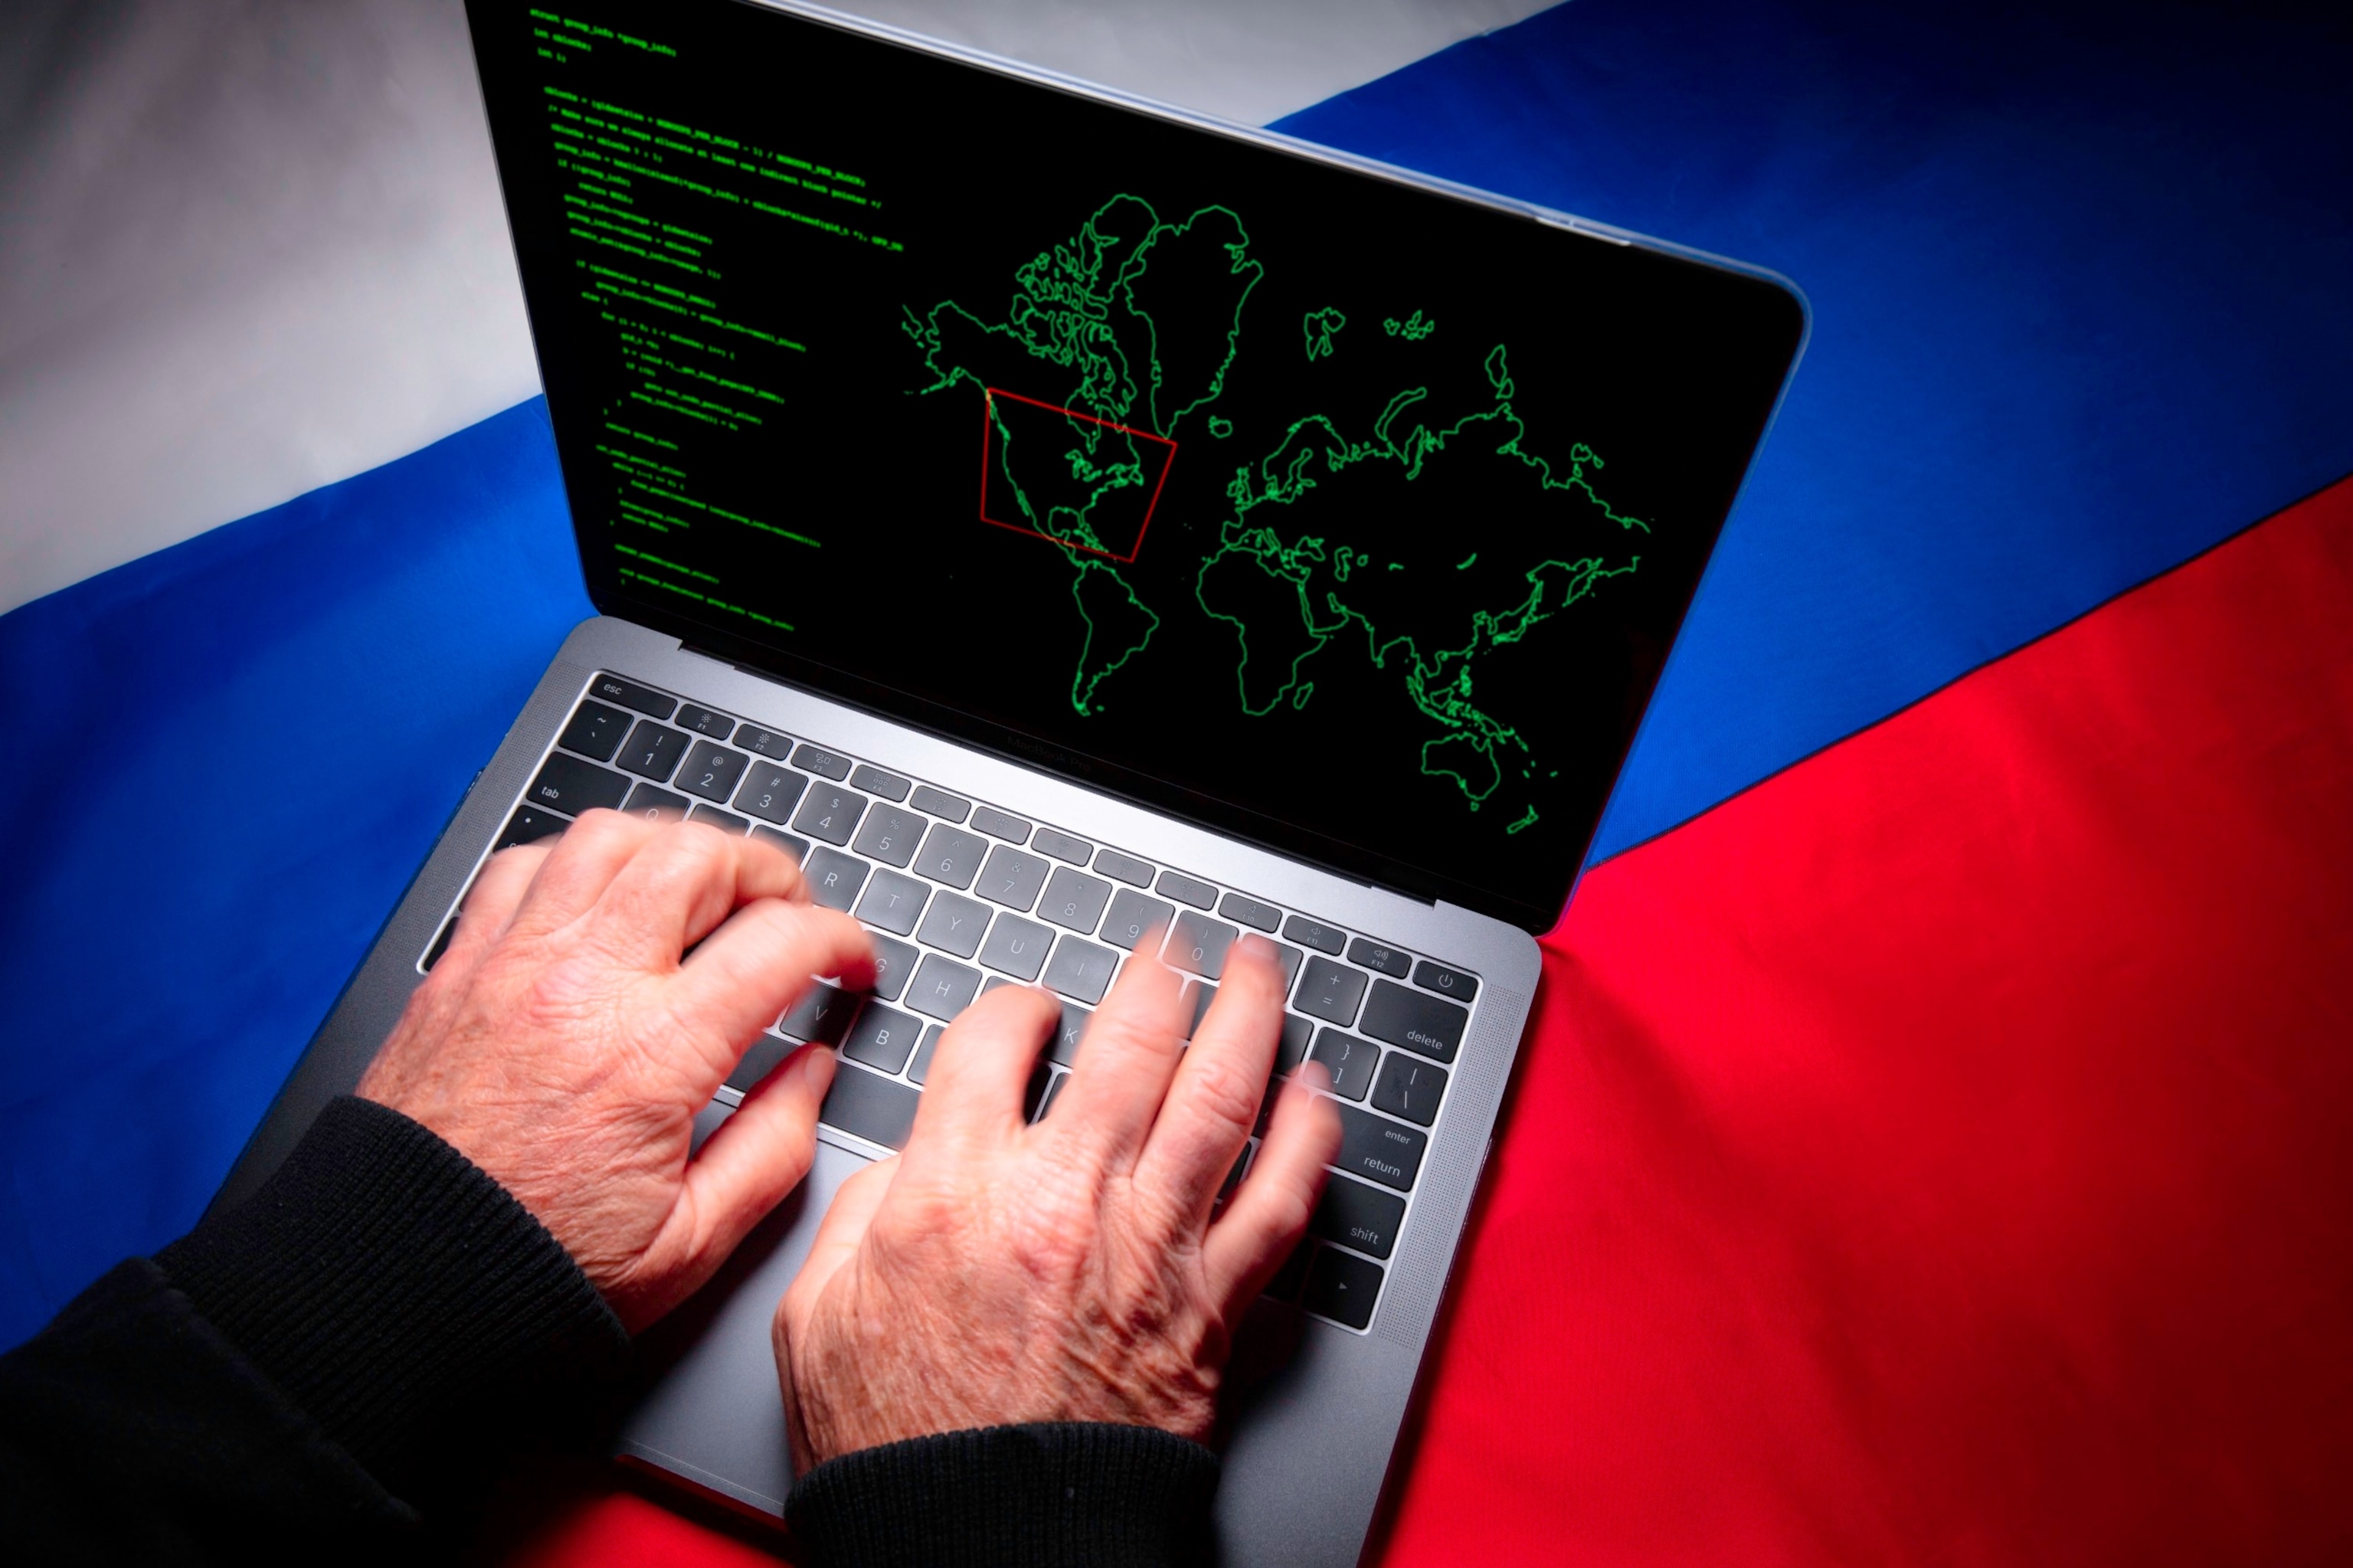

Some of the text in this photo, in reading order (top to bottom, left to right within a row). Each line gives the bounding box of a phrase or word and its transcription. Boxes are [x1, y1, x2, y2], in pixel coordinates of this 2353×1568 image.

[604, 683, 622, 695] esc
[656, 735, 663, 745] !
[1007, 735, 1065, 763] MacBook
[646, 753, 653, 764] 1
[712, 757, 723, 766] @
[701, 774, 713, 787] 2
[771, 778, 781, 787] #
[541, 786, 559, 799] tab
[760, 795, 771, 807] 3
[831, 799, 839, 807] $
[820, 817, 831, 828] 4
[889, 820, 900, 830] %
[879, 837, 892, 849] 5
[941, 859, 952, 871] 6
[825, 872, 837, 887] R
[1003, 880, 1014, 892] 7
[889, 894, 900, 907] T
[1065, 903, 1076, 916] 8
[951, 917, 961, 930] Y
[1127, 925, 1140, 938] 9
[1011, 939, 1024, 954] U
[875, 957, 888, 972] G
[1371, 959, 1384, 968] F12
[1330, 976, 1340, 984] +
[935, 981, 951, 997] H
[815, 1005, 828, 1021] V
[876, 1030, 889, 1044] B
[1064, 1027, 1078, 1044] K
[1407, 1030, 1443, 1050] delete
[1385, 1130, 1411, 1144] enter
[1363, 1157, 1401, 1177] return
[1350, 1227, 1379, 1245] shift
